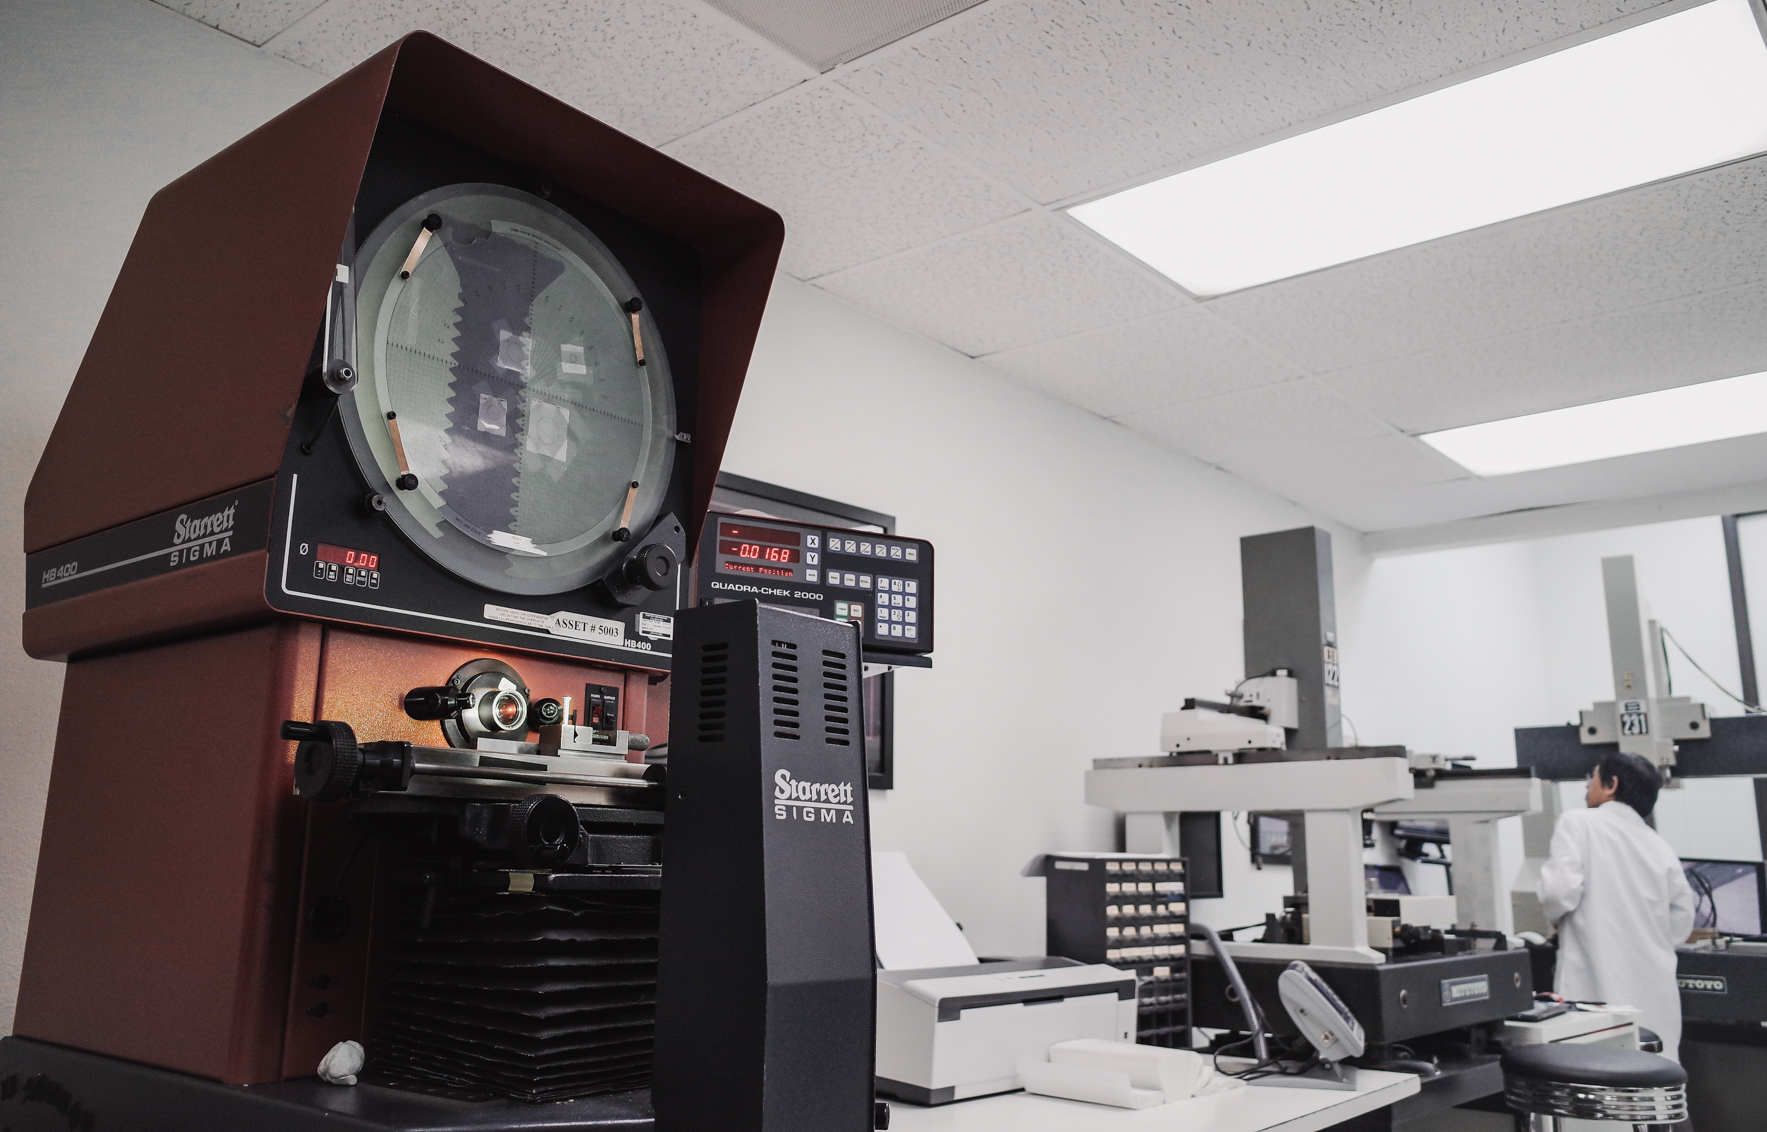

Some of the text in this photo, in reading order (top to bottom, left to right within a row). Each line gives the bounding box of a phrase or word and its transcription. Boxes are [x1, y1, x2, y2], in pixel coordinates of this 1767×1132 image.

[173, 504, 236, 544] Starrett
[169, 537, 231, 567] SIGMA
[345, 550, 378, 568] 0.00
[731, 544, 790, 563] -0.0168
[42, 561, 78, 583] HB400
[725, 563, 794, 577] Current Position
[711, 581, 824, 601] QUADRA-CHEK 2000
[555, 617, 619, 637] ASSET # 5003
[624, 638, 651, 651] HB400
[1622, 713, 1647, 735] 231
[774, 768, 854, 804] Starrett
[774, 805, 854, 824] SIGMA
